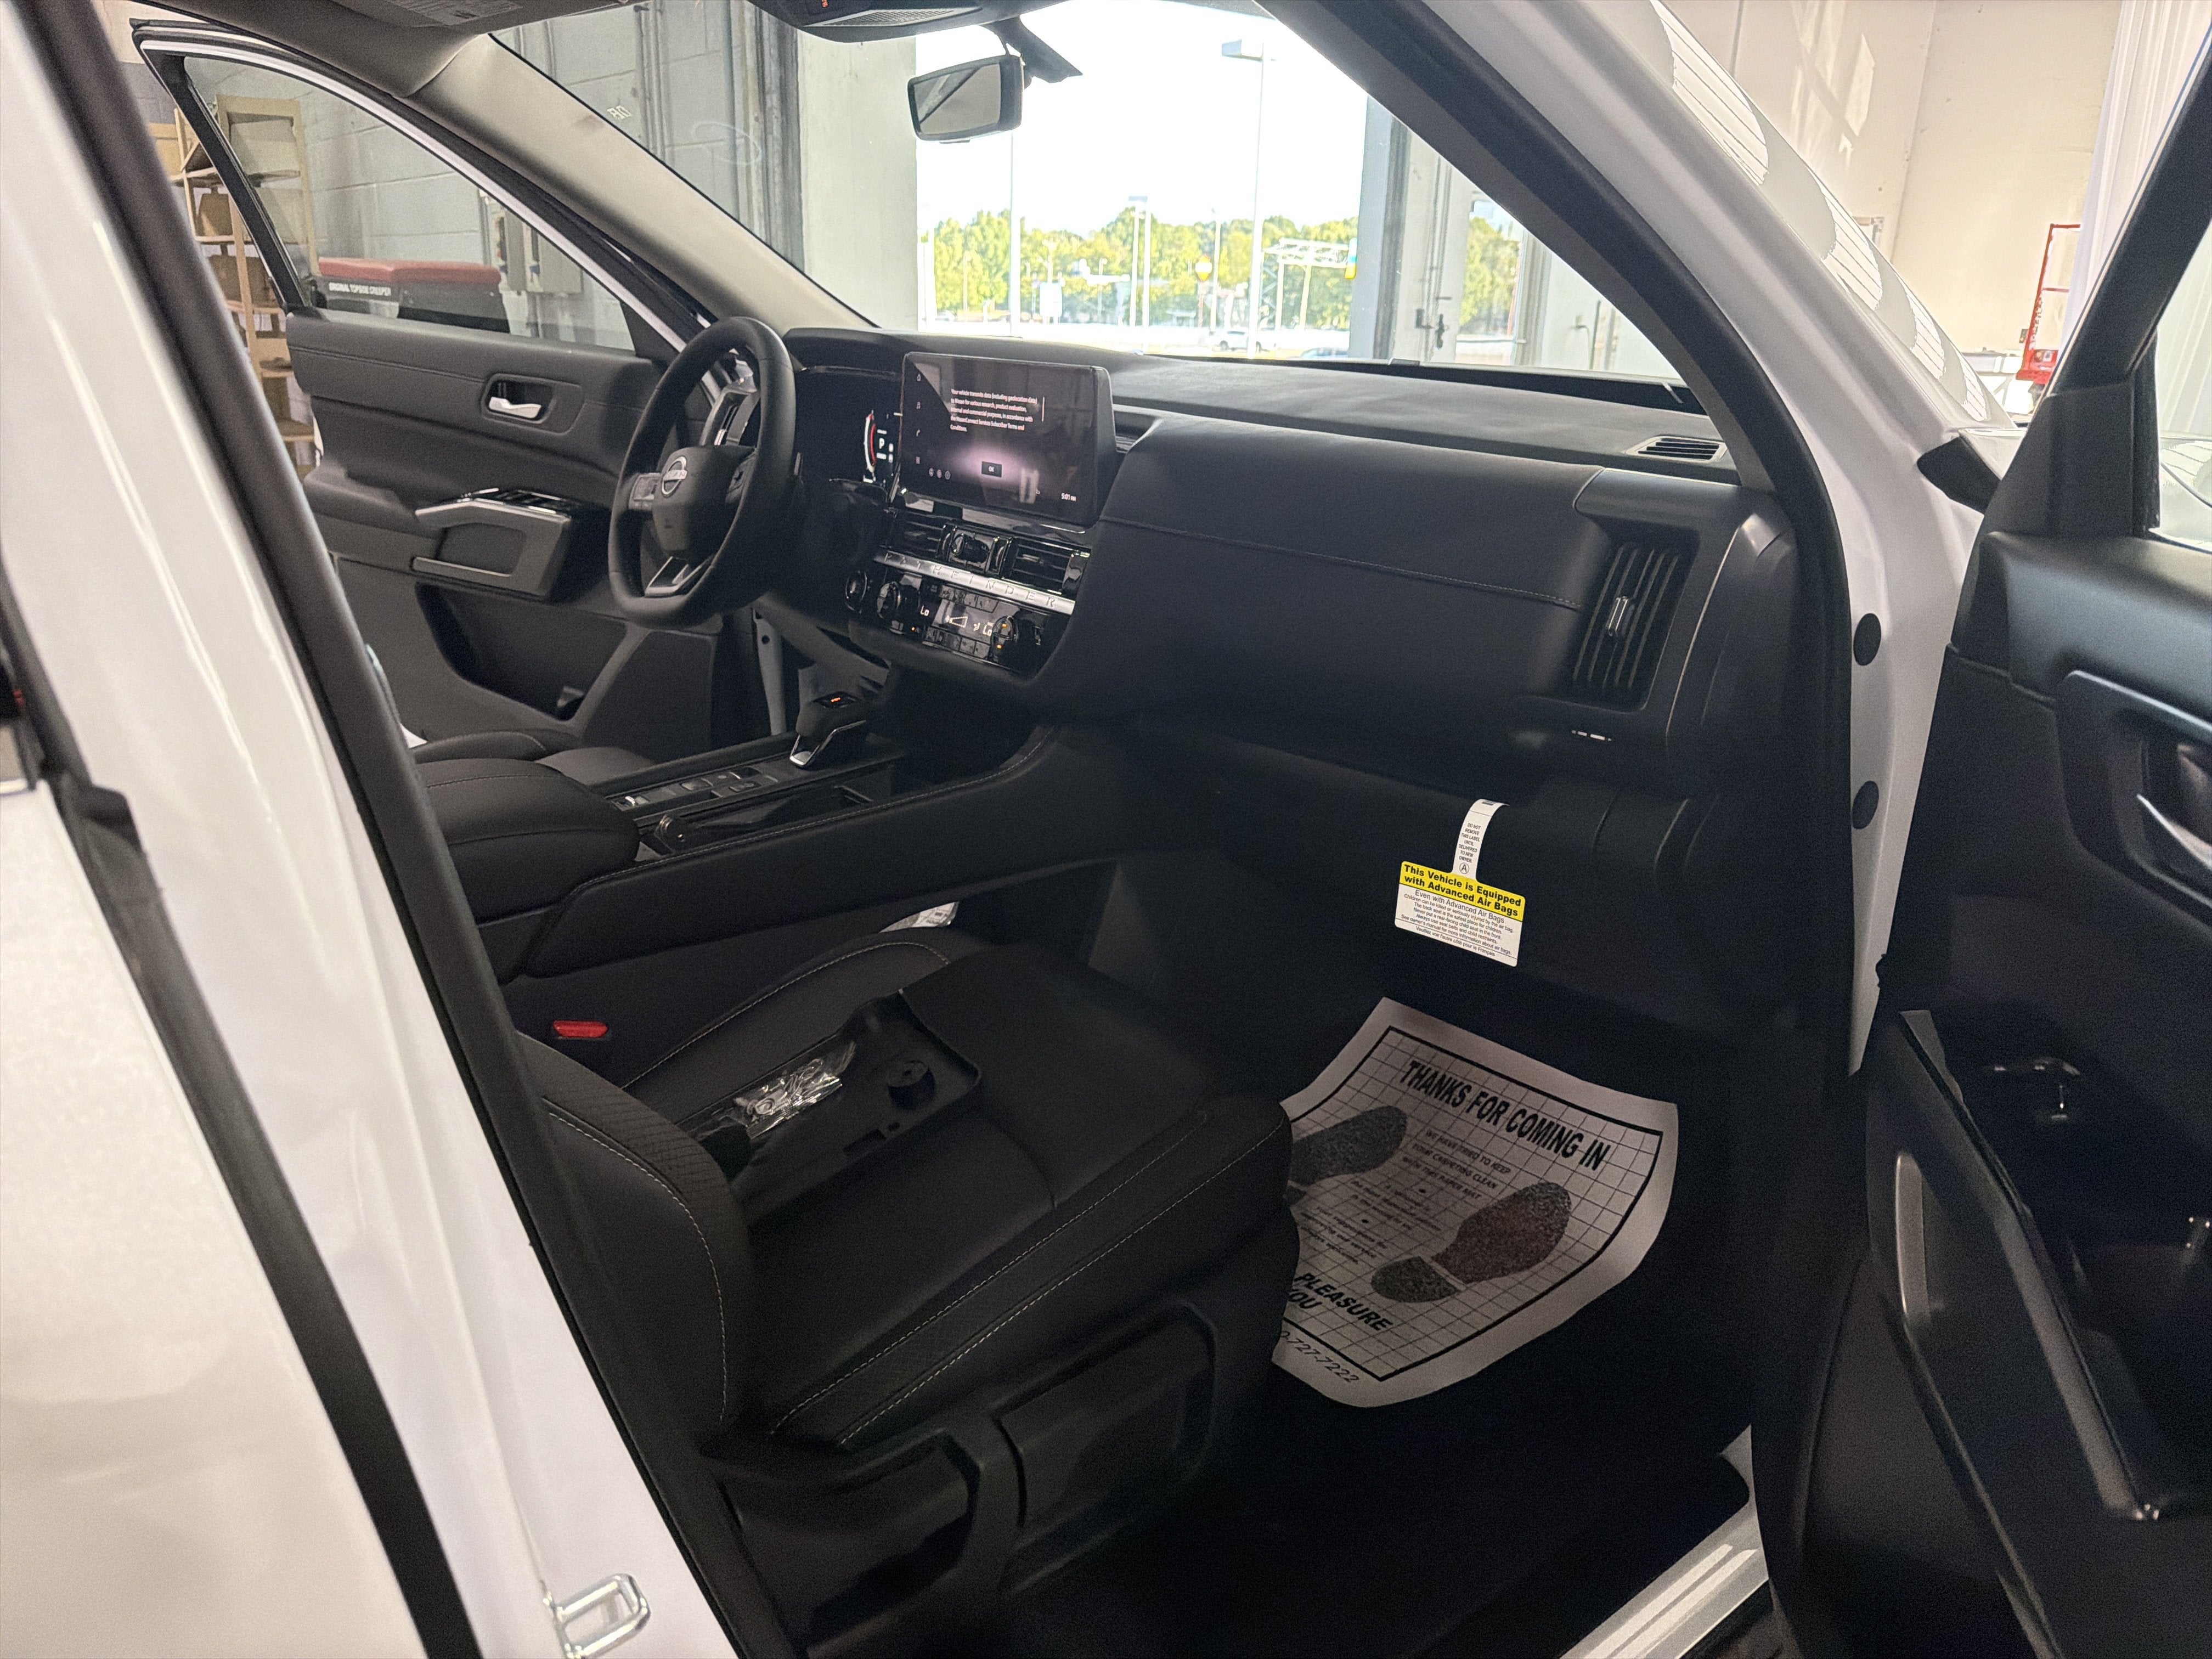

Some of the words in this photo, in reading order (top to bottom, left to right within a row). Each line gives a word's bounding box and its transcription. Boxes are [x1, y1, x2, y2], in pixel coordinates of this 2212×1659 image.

[879, 438, 884, 449] P
[1404, 865, 1424, 876] This
[1428, 871, 1462, 888] Vehicle
[1465, 883, 1473, 891] is
[1477, 885, 1521, 906] Equipped
[1404, 876, 1424, 887] with
[1427, 882, 1474, 902] Advanced
[1477, 897, 1491, 907] Air
[1494, 902, 1517, 916] Bags
[1415, 890, 1431, 900] Even
[1446, 900, 1476, 914] Advanced
[1488, 913, 1504, 923] Bags
[1437, 916, 1458, 926] rear-facing
[1452, 910, 1470, 918] seriously
[1459, 934, 1481, 944] information
[1400, 1061, 1471, 1108] THANKS
[1469, 1091, 1509, 1126] FOR
[1508, 1109, 1583, 1158] COMING
[1584, 1139, 1610, 1171] IN
[1294, 1273, 1393, 1330] PLEASURE
